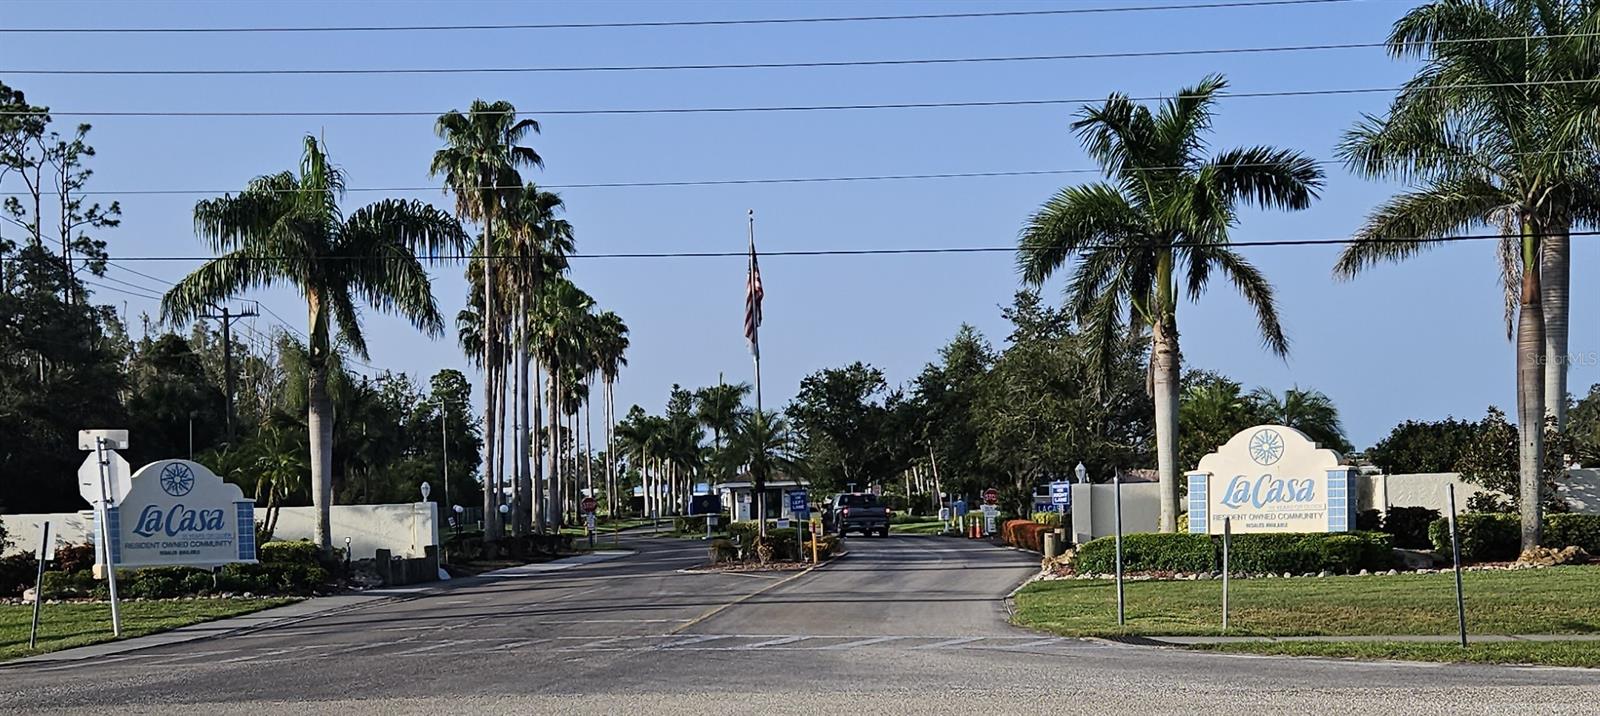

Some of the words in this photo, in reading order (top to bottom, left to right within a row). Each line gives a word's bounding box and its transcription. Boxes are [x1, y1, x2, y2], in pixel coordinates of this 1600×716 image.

[1220, 474, 1251, 509] La
[1252, 473, 1315, 509] Casa
[132, 504, 163, 538] La
[164, 503, 225, 537] Casa
[1248, 513, 1276, 521] OWNED
[1277, 512, 1324, 520] COMMUNITY
[125, 542, 160, 550] RESIDENT
[162, 541, 188, 549] OWNED
[190, 539, 233, 548] COMMUNITY
